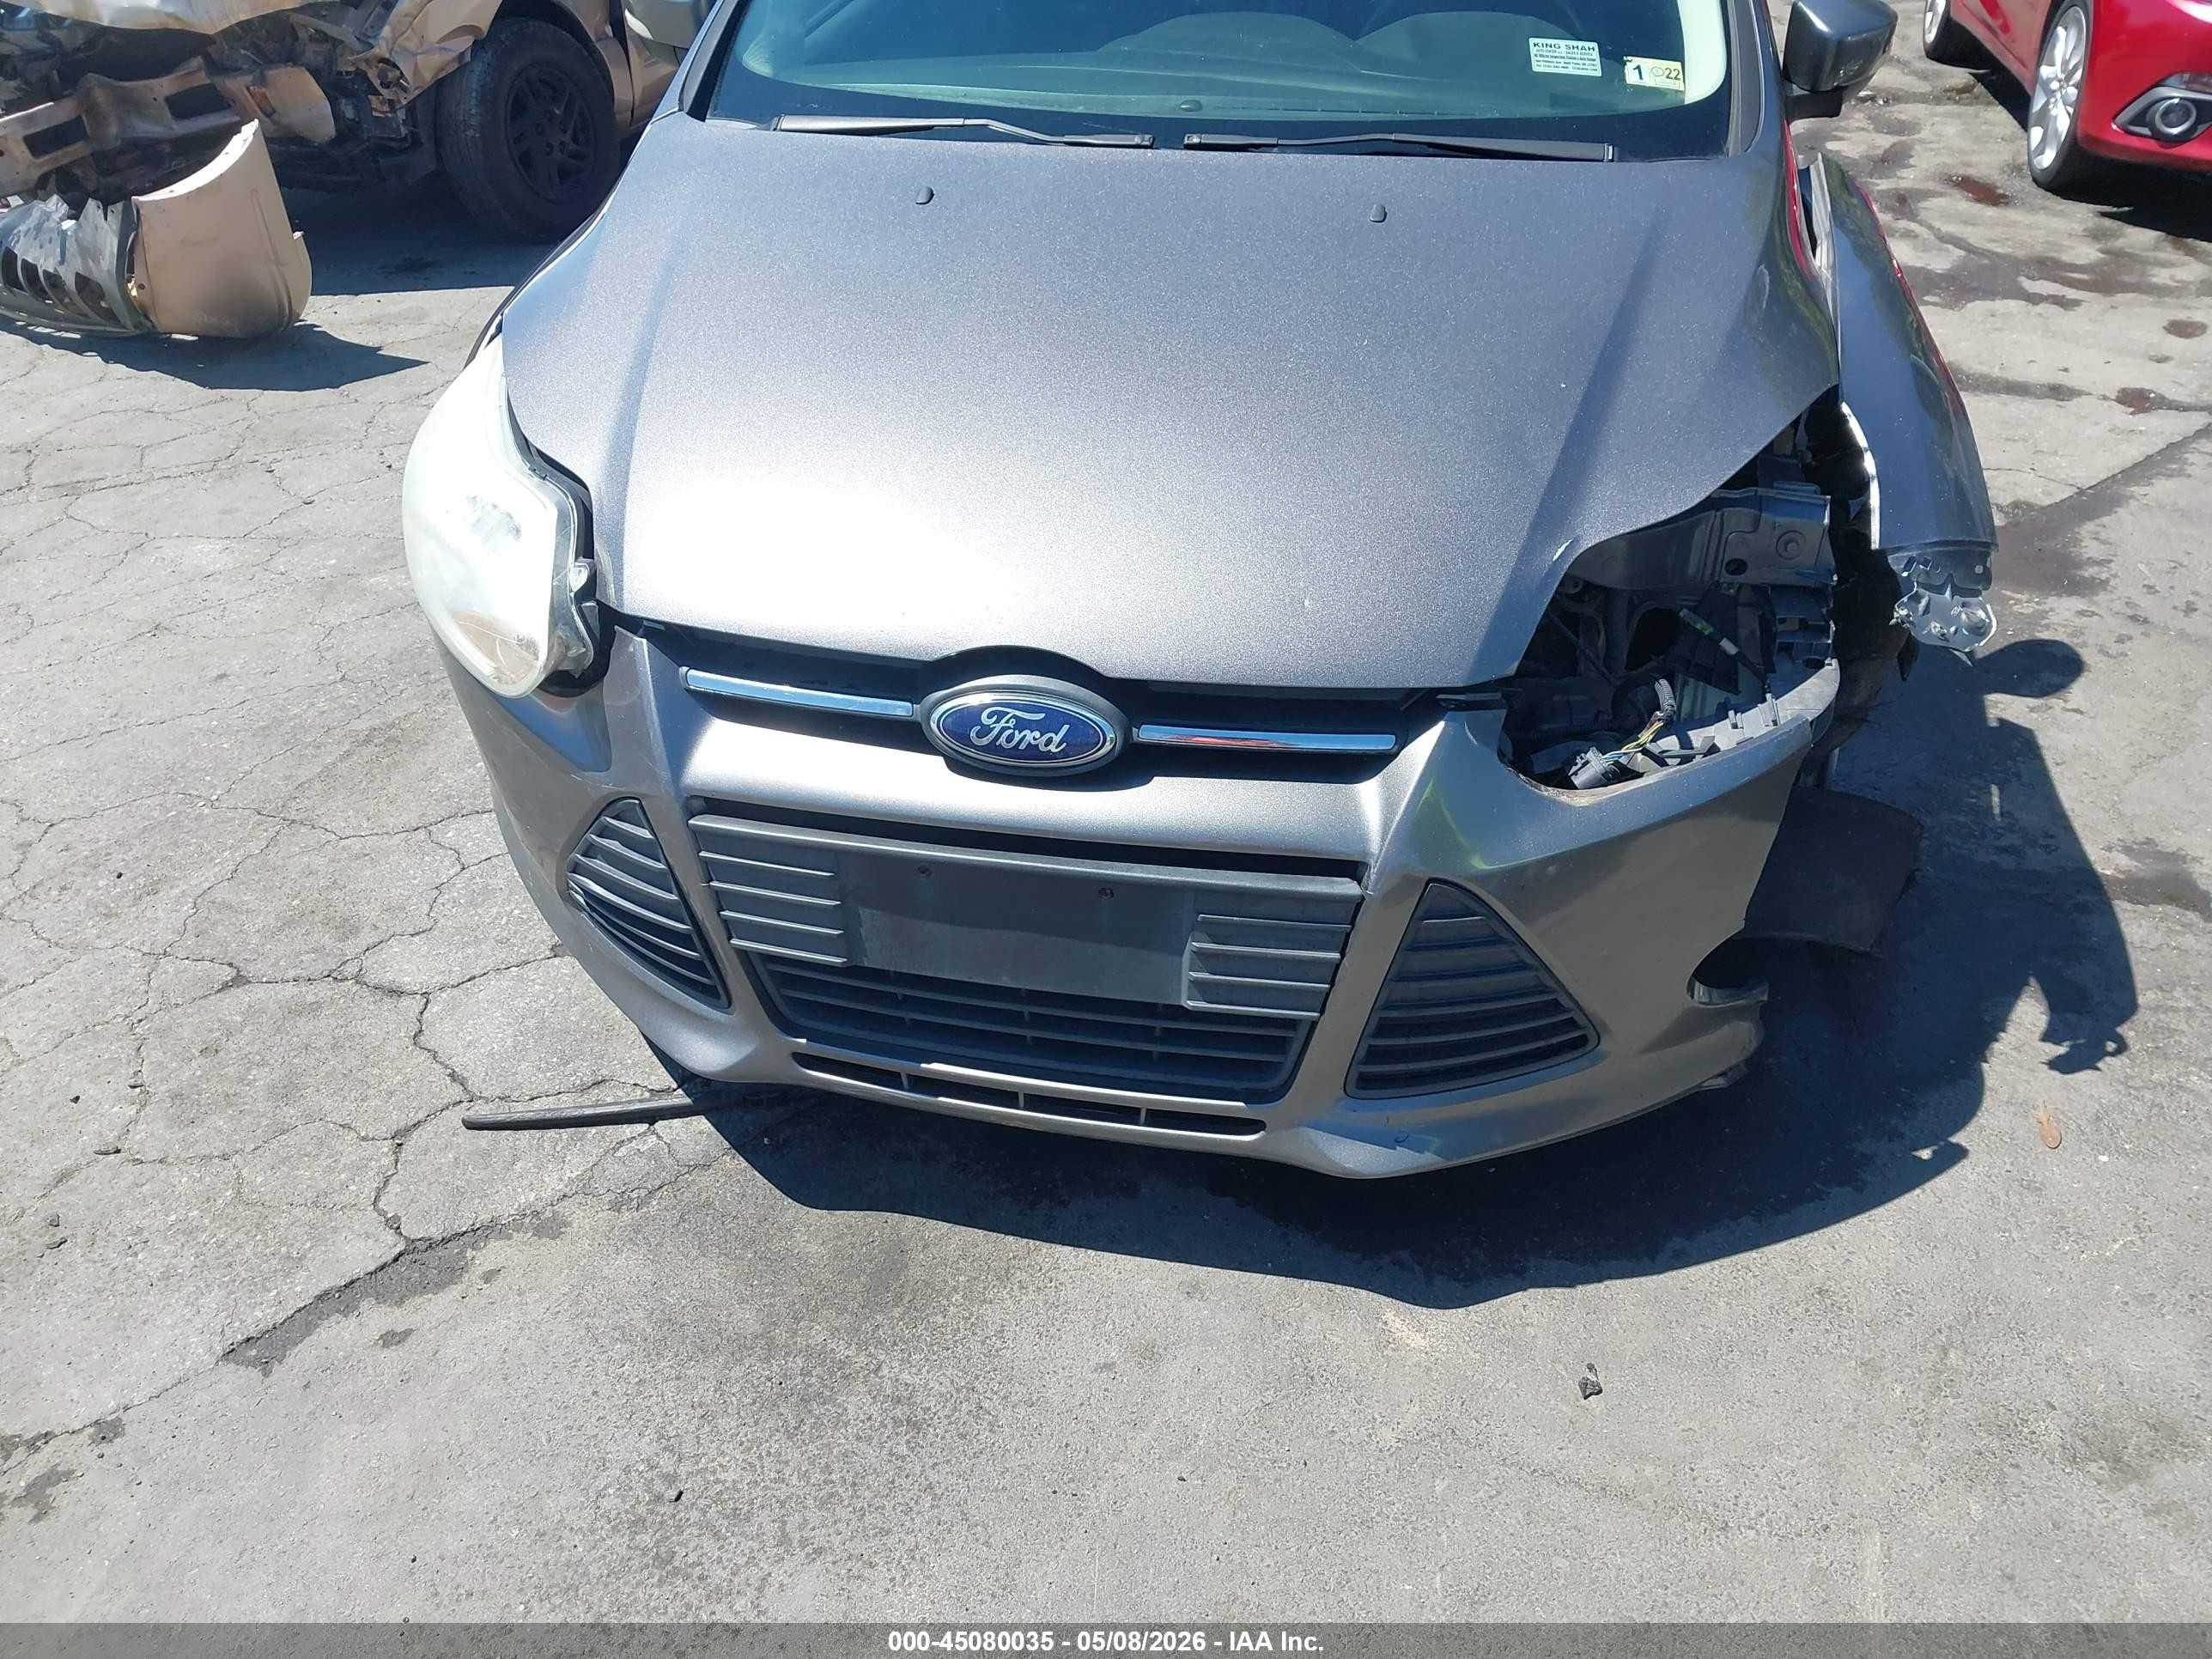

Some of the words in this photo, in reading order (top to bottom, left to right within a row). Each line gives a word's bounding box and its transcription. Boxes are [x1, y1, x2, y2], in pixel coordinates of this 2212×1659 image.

[1632, 64, 1644, 81] 1
[1665, 68, 1680, 81] 22
[969, 707, 1071, 753] Ford
